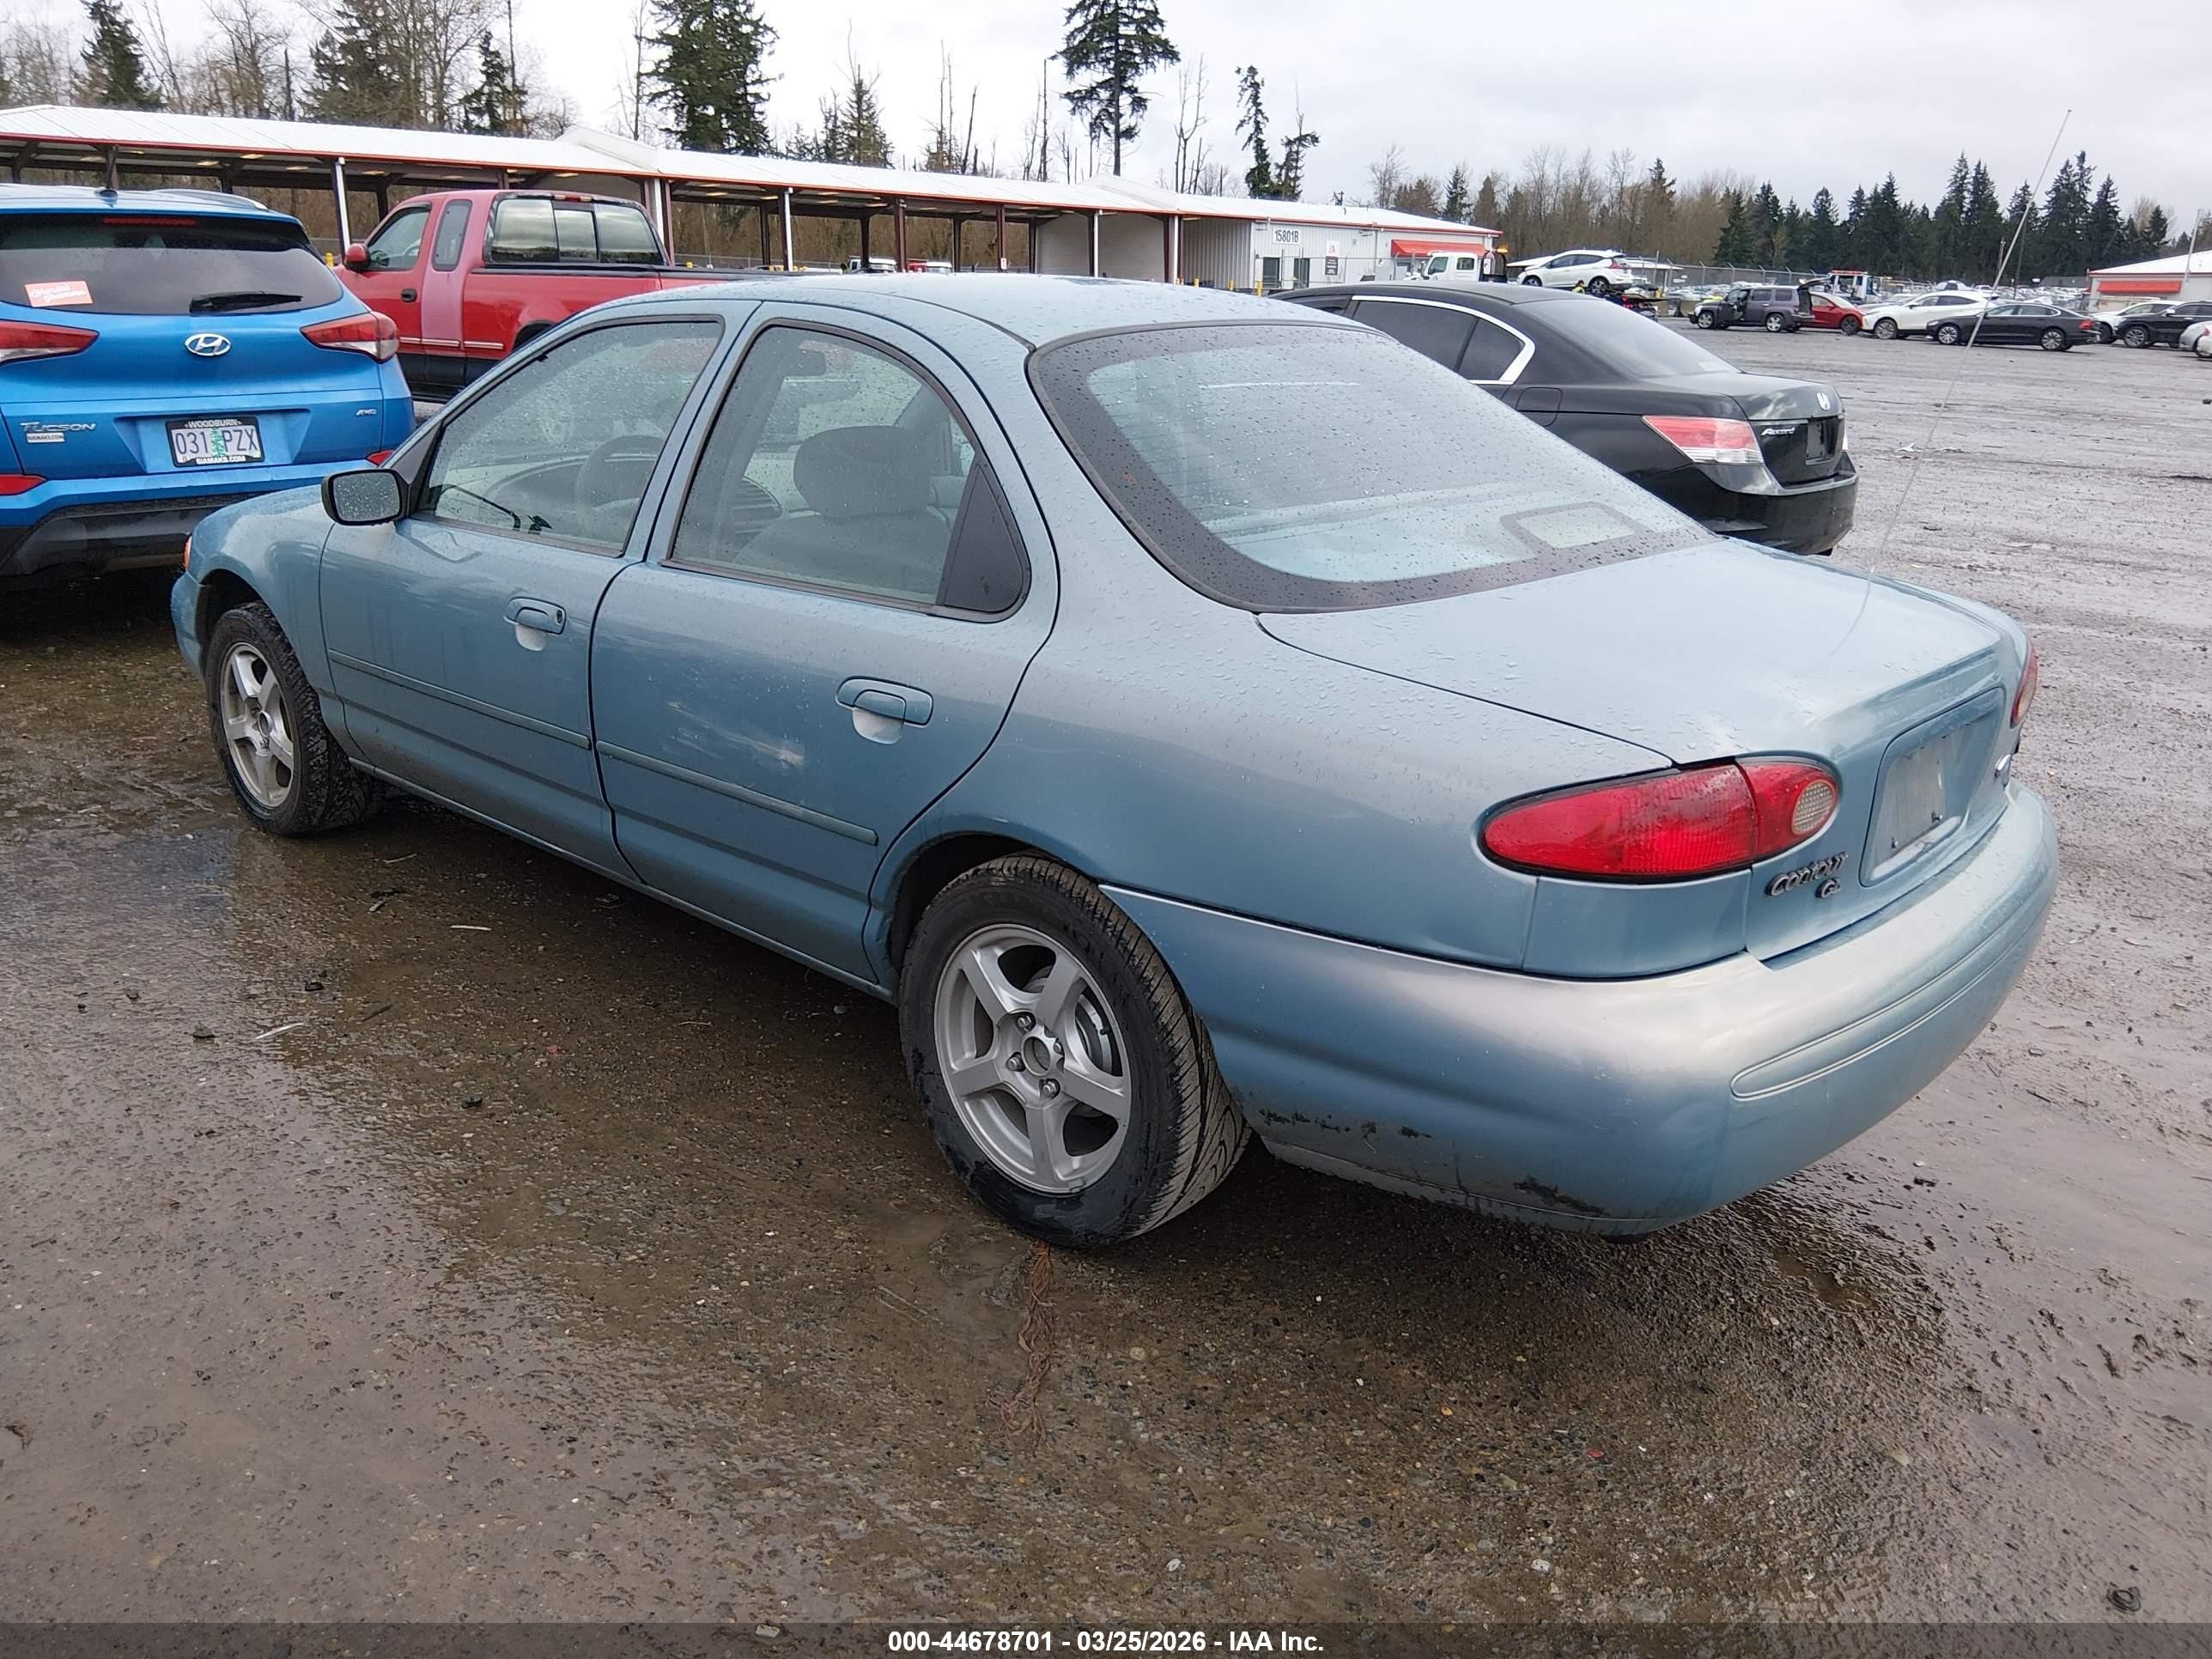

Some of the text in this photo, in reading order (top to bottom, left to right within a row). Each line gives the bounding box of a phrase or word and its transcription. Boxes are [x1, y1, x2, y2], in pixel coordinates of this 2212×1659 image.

[1274, 229, 1299, 244] 15801B
[187, 419, 239, 428] WOODBURN
[1759, 427, 1796, 436] Accord
